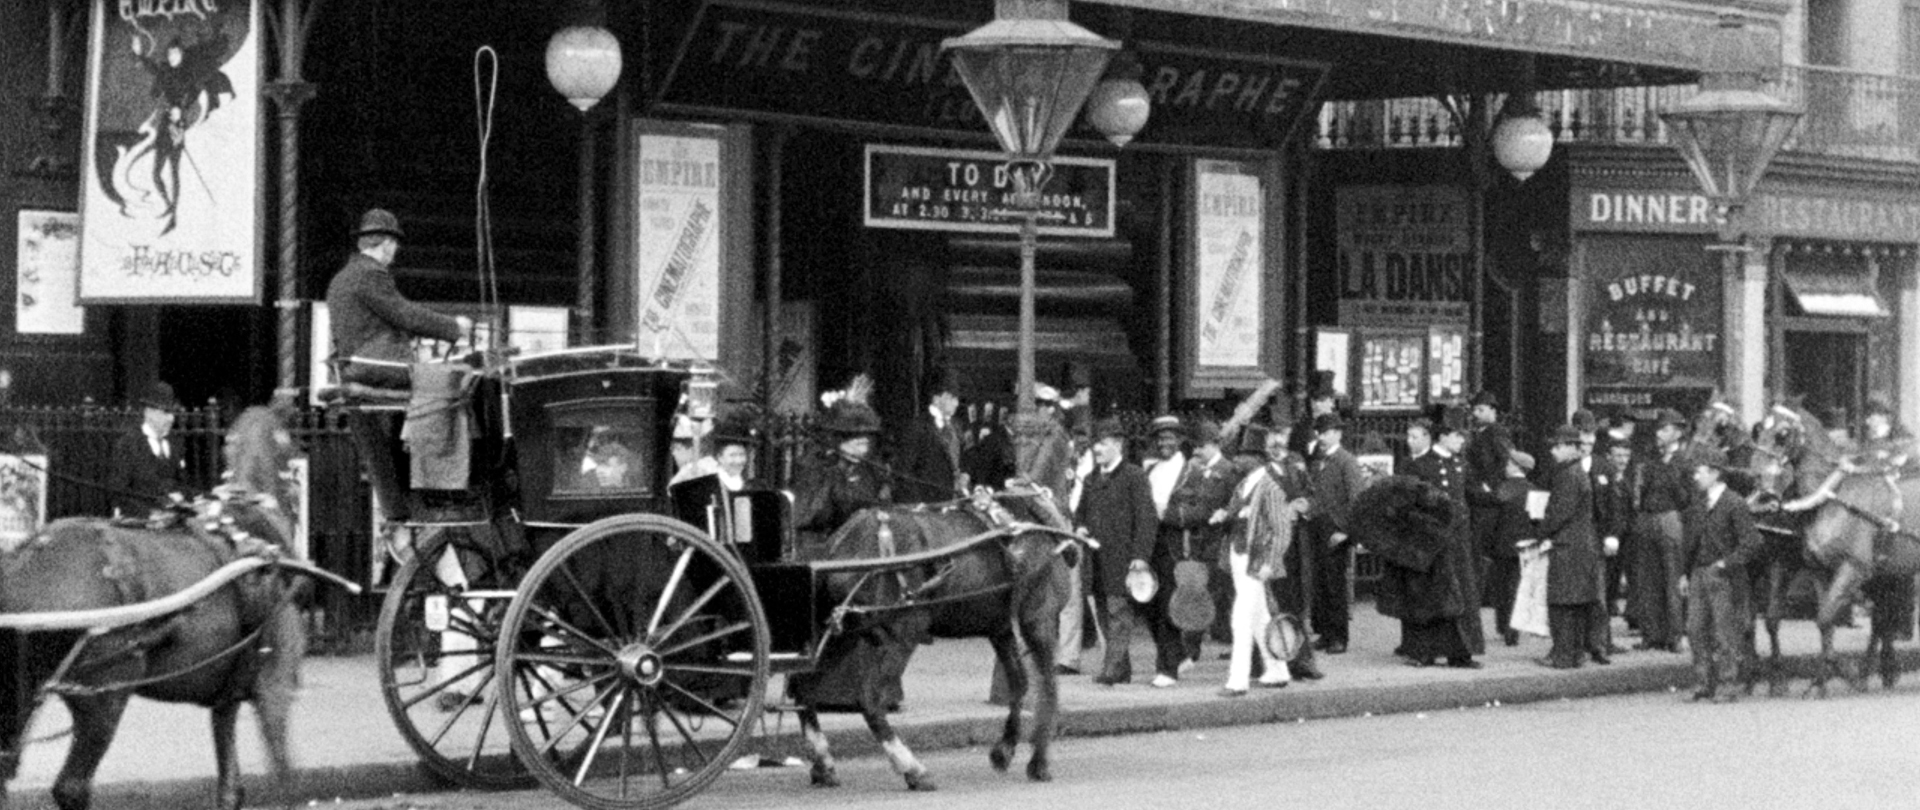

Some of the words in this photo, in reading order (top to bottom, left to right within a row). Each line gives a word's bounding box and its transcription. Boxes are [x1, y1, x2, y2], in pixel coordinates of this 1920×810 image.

[711, 21, 823, 71] THE
[948, 162, 979, 186] TO
[994, 165, 1045, 188] DY
[892, 203, 909, 216] AT
[901, 186, 931, 200] AND
[943, 189, 988, 203] EVERY
[1002, 192, 1087, 210] AFNOON,
[1340, 251, 1377, 300] LA
[1608, 275, 1696, 301] BUFFET
[1589, 321, 1718, 351] RESTAURANT
